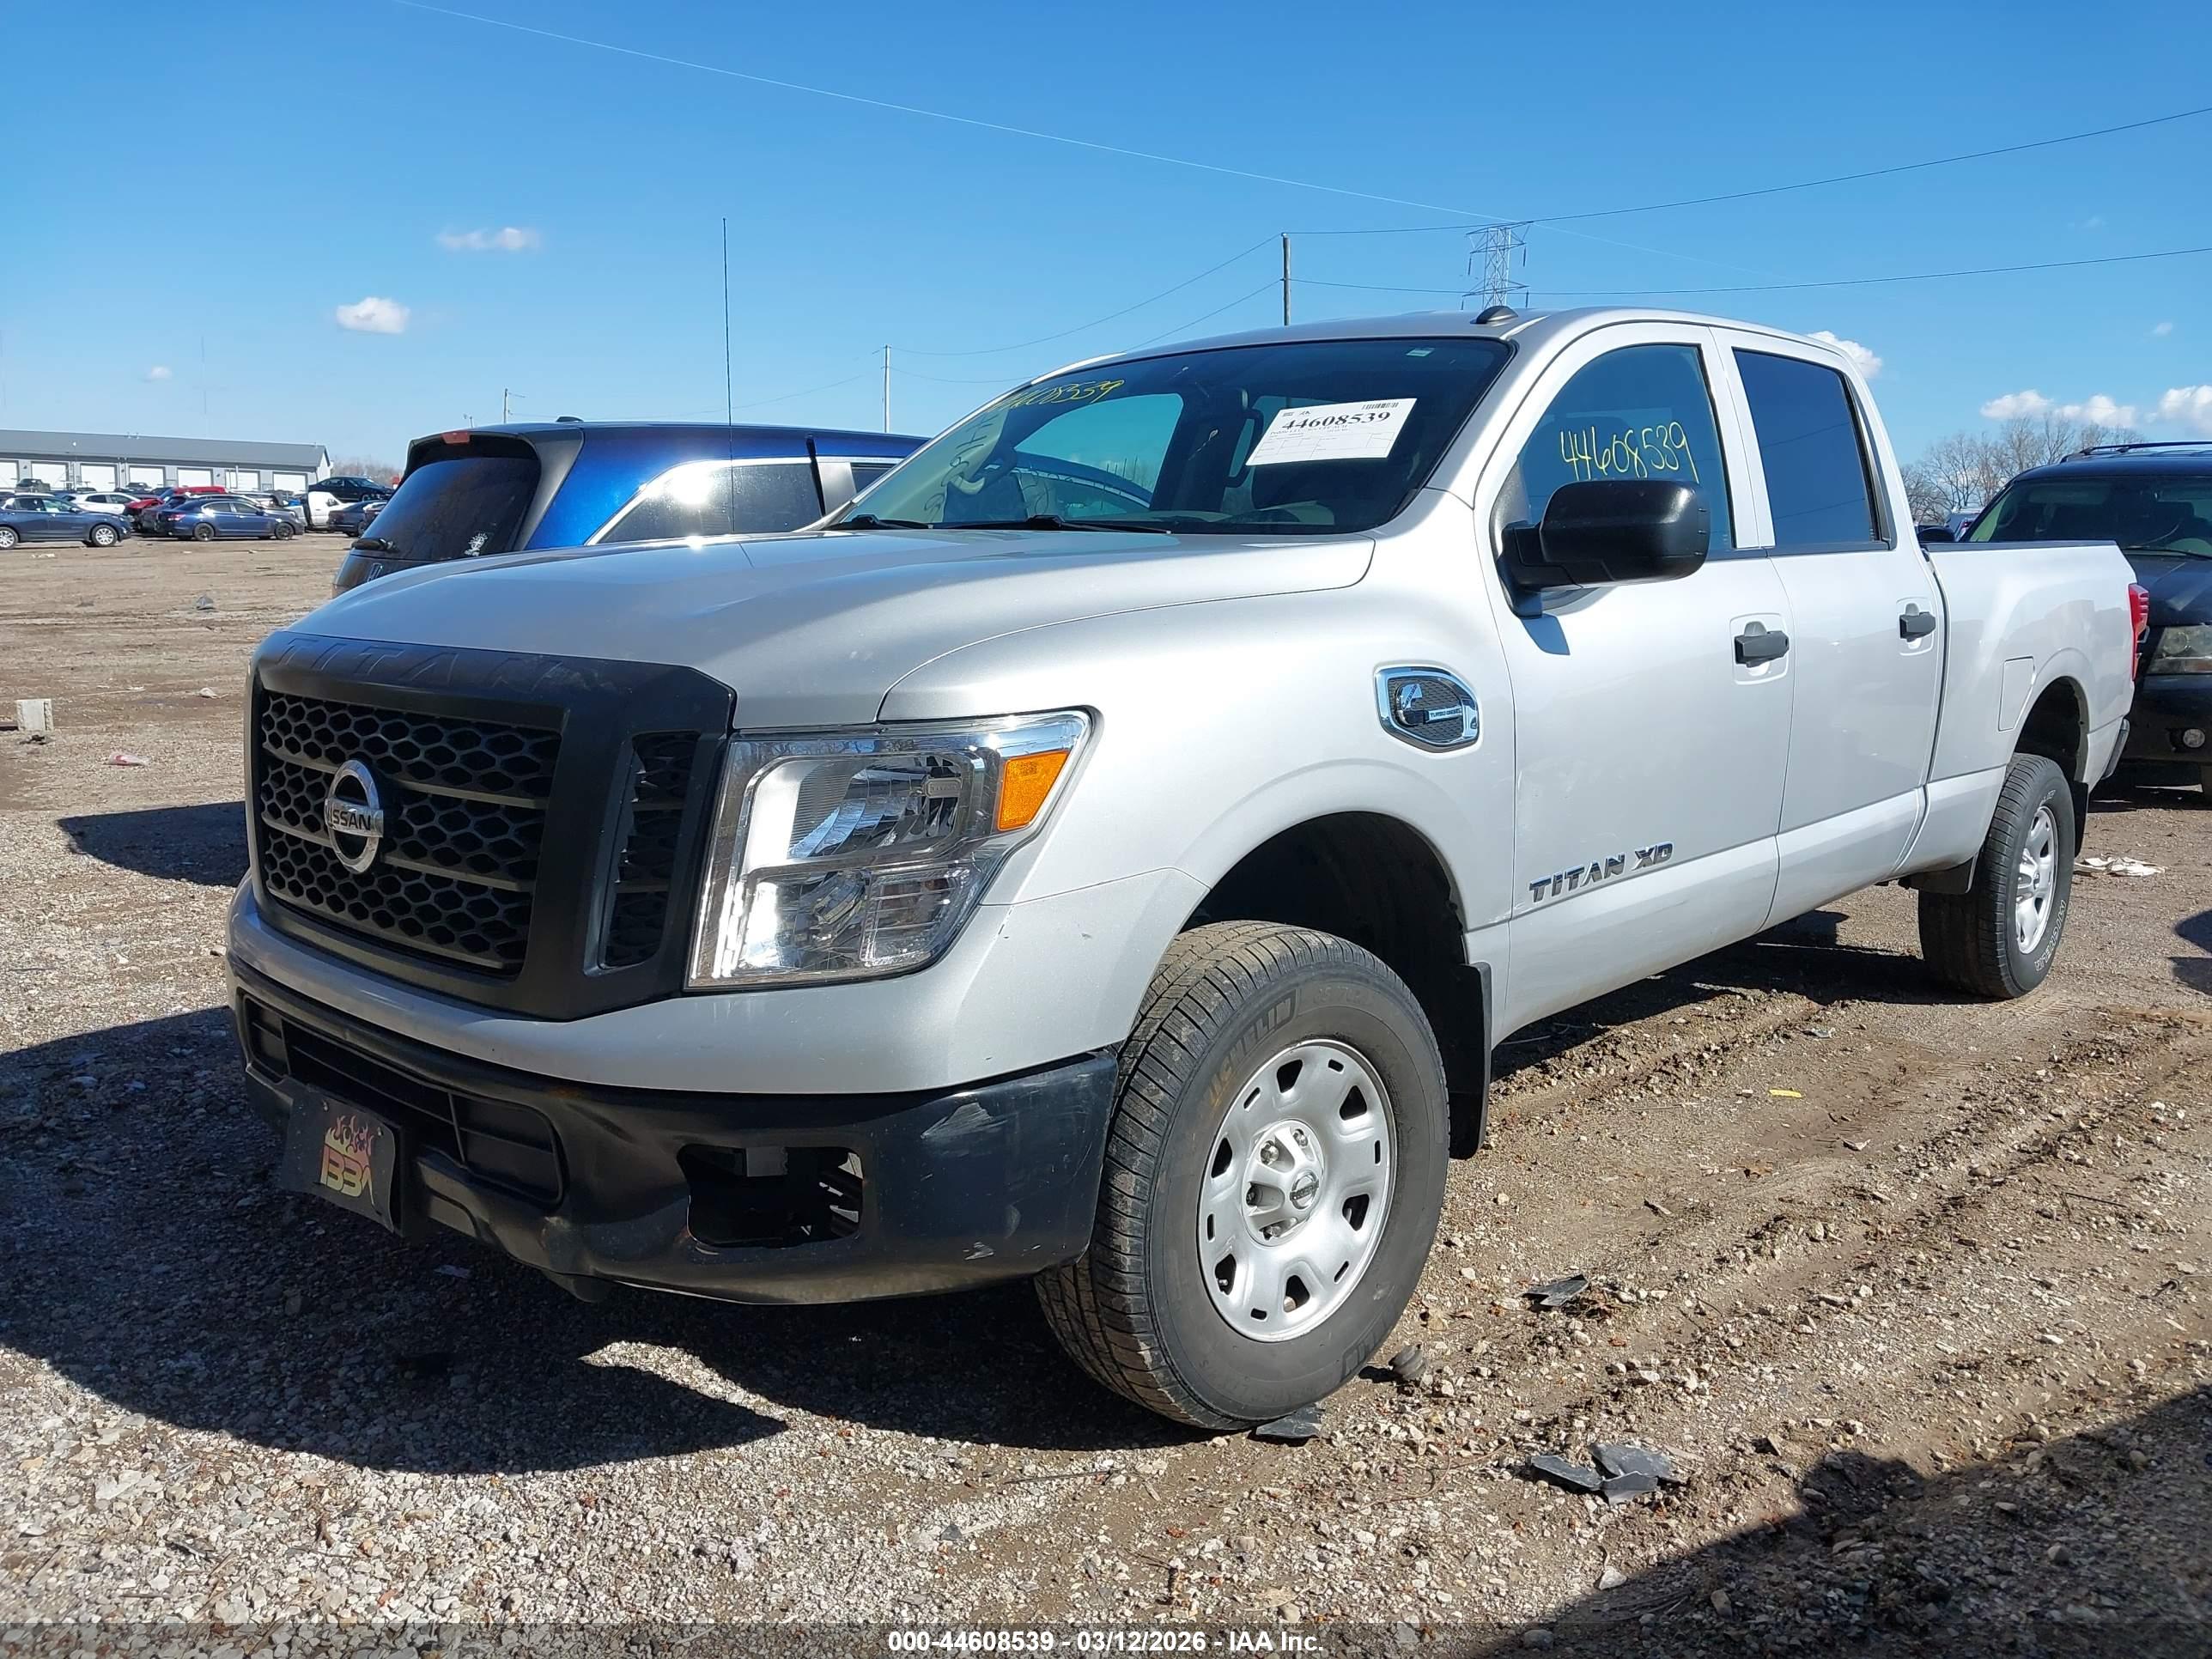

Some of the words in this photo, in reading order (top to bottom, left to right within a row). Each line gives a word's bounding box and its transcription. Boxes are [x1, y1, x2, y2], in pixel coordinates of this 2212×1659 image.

[1282, 411, 1391, 430] 44608539
[1559, 421, 1700, 485] 44608539
[1528, 854, 1626, 903] TITAN
[1632, 841, 1674, 872] XD
